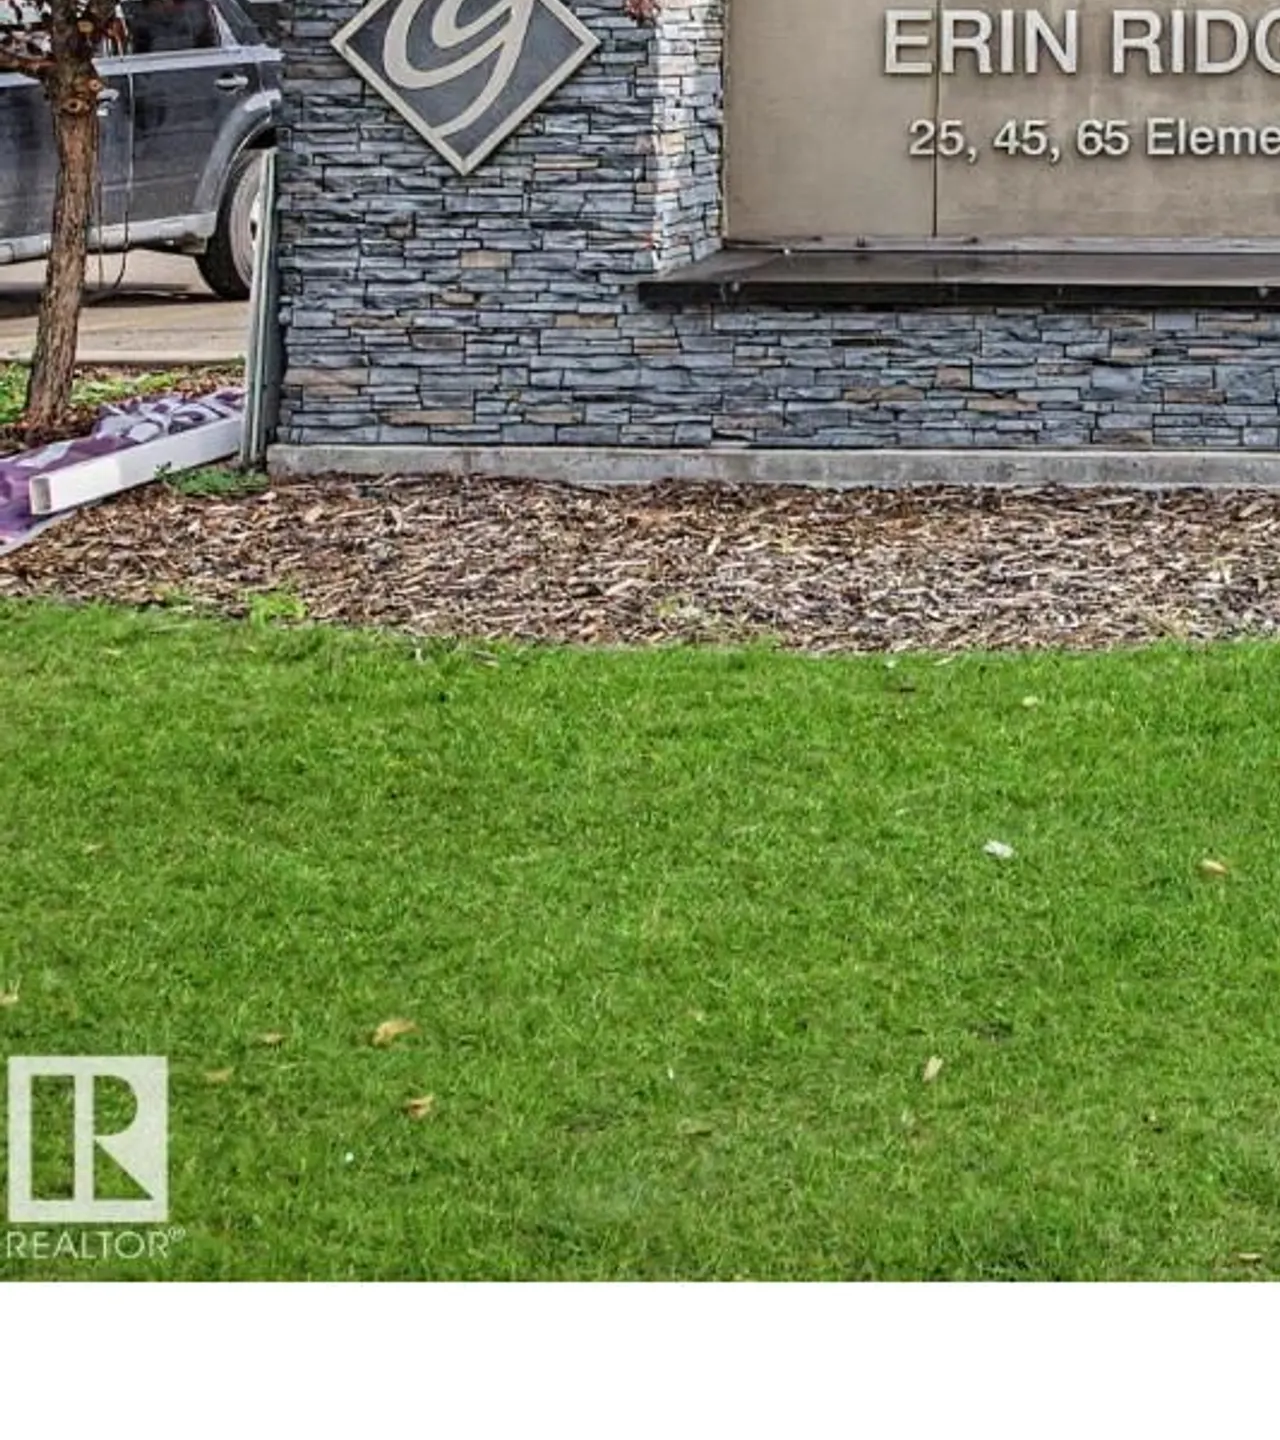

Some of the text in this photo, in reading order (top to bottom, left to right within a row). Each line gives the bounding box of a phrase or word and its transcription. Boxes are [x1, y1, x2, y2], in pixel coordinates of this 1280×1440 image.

[883, 8, 1078, 75] ERIN
[909, 120, 977, 163] 25,
[993, 120, 1061, 163] 45,
[1076, 119, 1130, 156] 65
